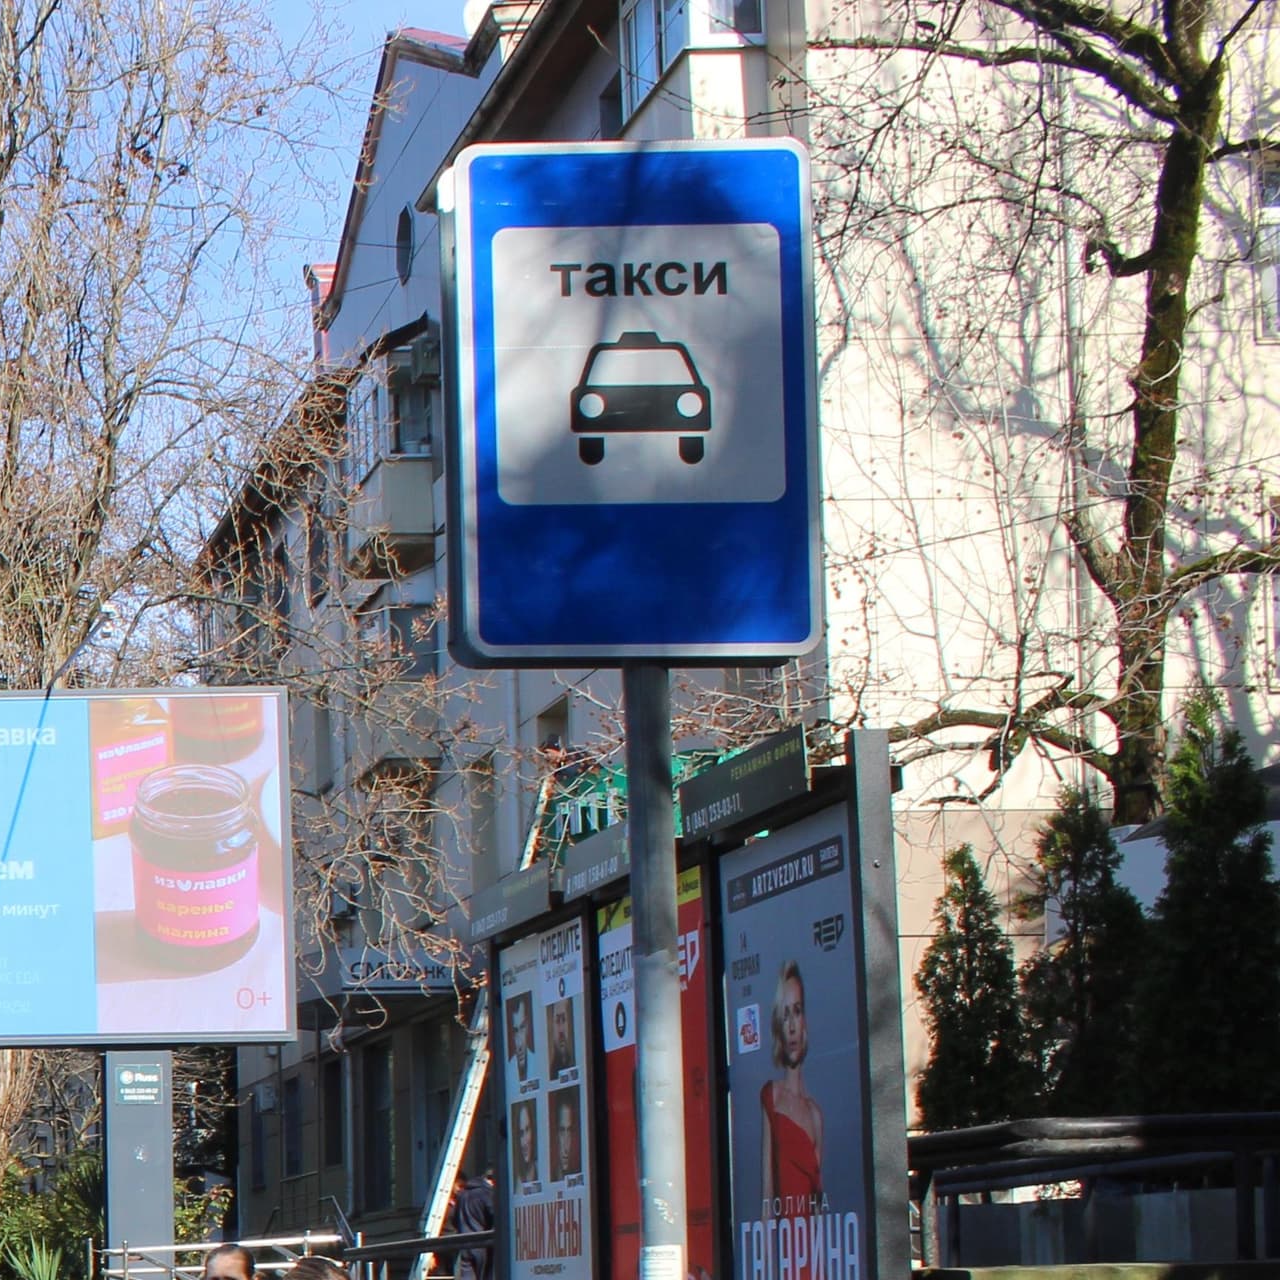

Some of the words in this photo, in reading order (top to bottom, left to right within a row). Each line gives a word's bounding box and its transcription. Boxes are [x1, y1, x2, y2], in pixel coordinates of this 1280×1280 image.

[550, 259, 728, 298] такси
[154, 875, 176, 889] из
[192, 868, 247, 891] лавки
[751, 854, 814, 898] ARTZVEZDY.RU
[3, 903, 61, 919] минут
[156, 898, 235, 917] варенье
[157, 923, 230, 940] малина
[236, 987, 272, 1010] 0+
[762, 1192, 830, 1217] ПОЛИНА
